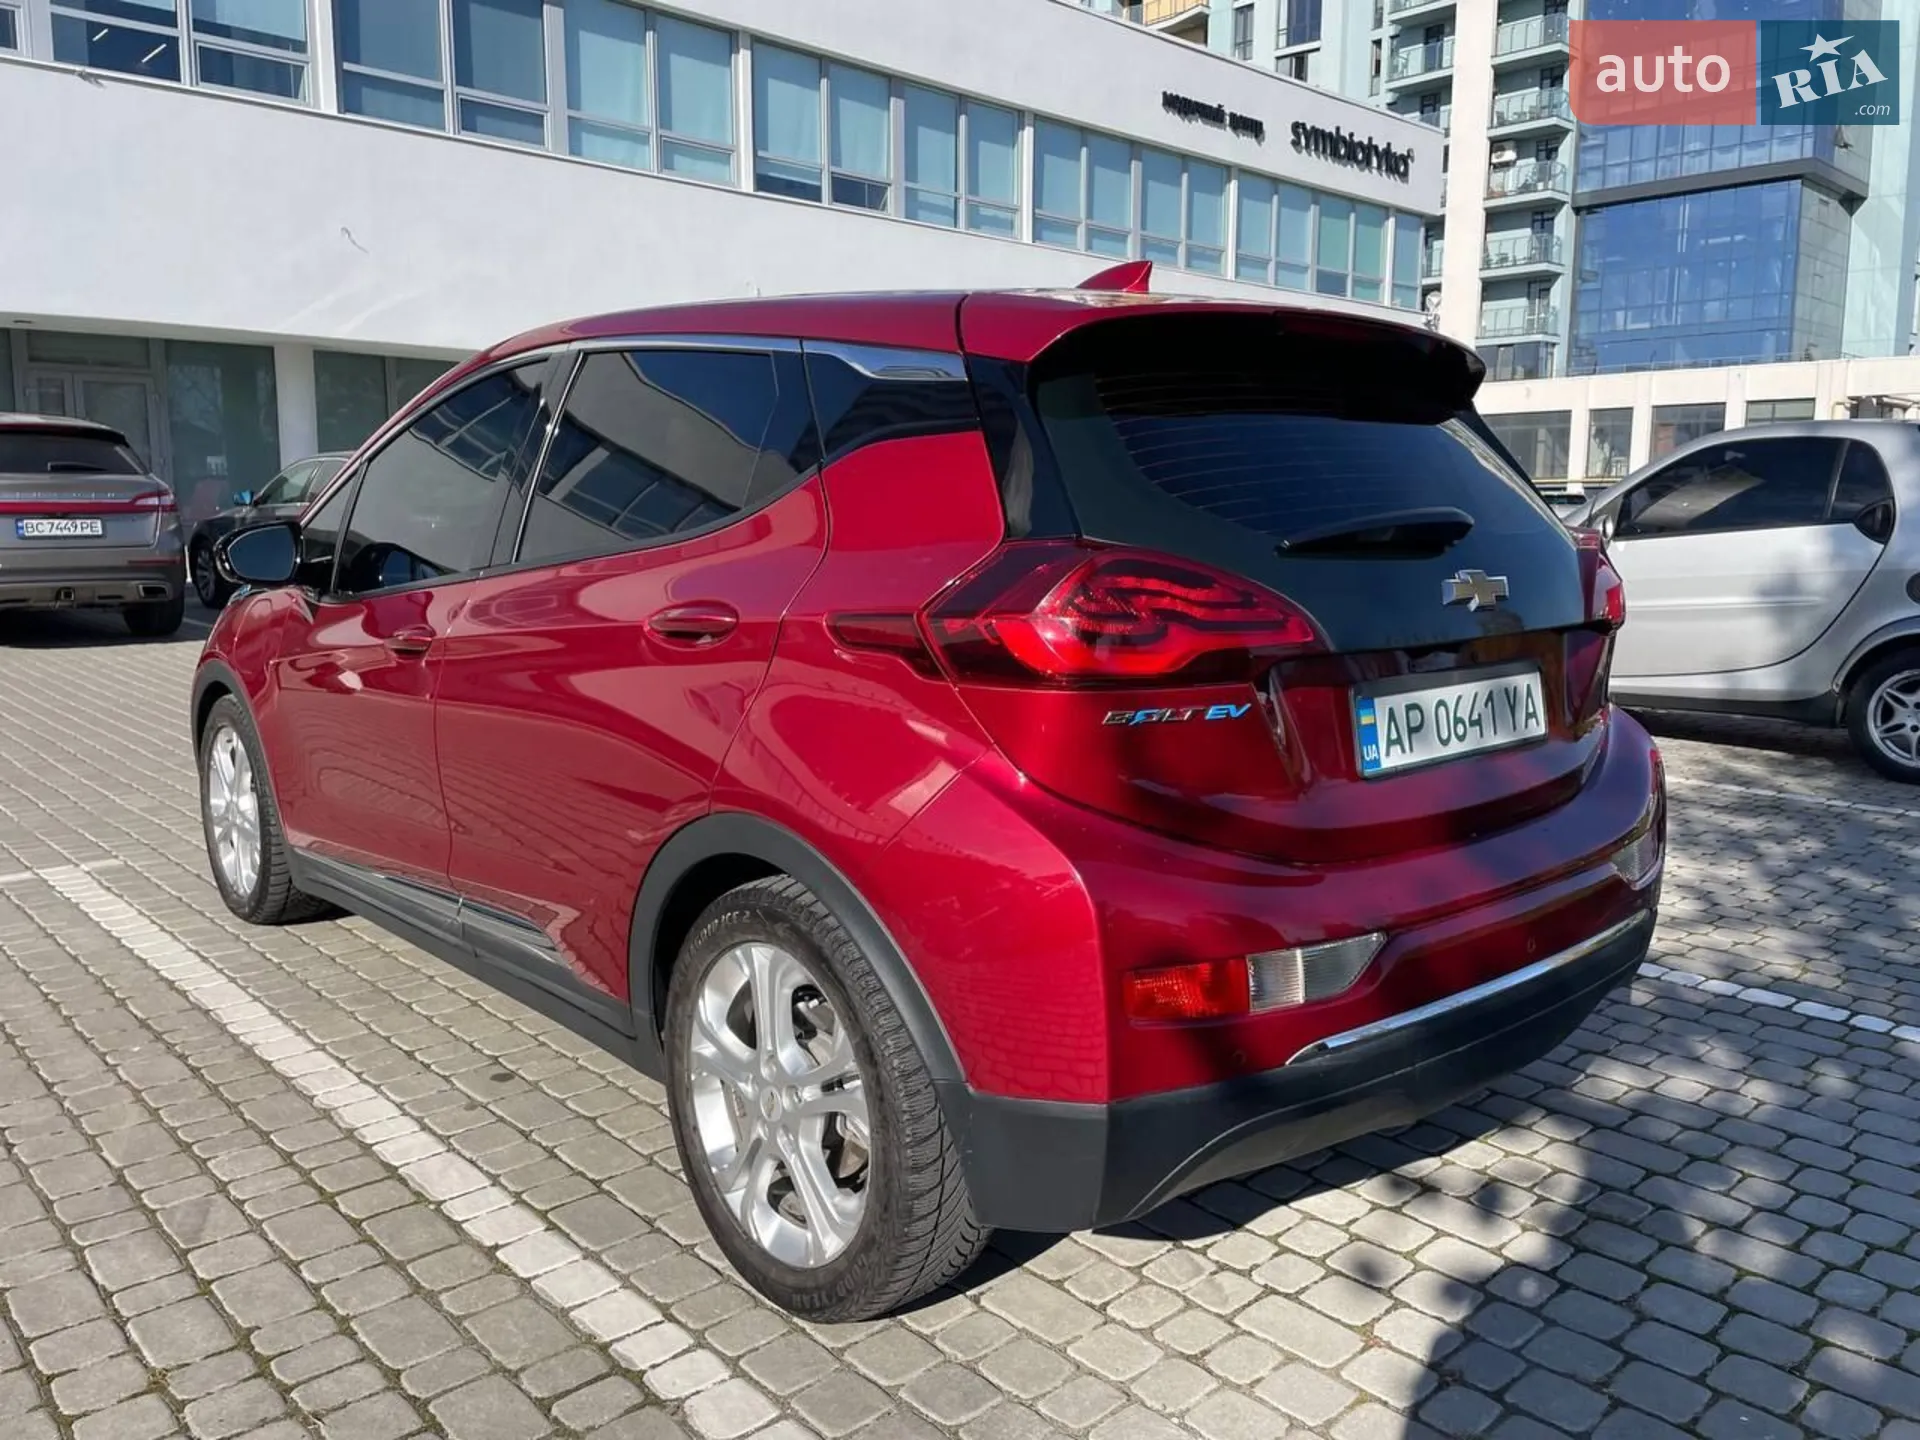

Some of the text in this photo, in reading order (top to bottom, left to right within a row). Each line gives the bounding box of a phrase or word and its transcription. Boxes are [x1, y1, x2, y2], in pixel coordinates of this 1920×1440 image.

[25, 521, 100, 534] BC 7449 PE
[1204, 703, 1251, 721] EV
[1385, 683, 1540, 756] AP 0641 YA
[1363, 745, 1379, 761] UA
